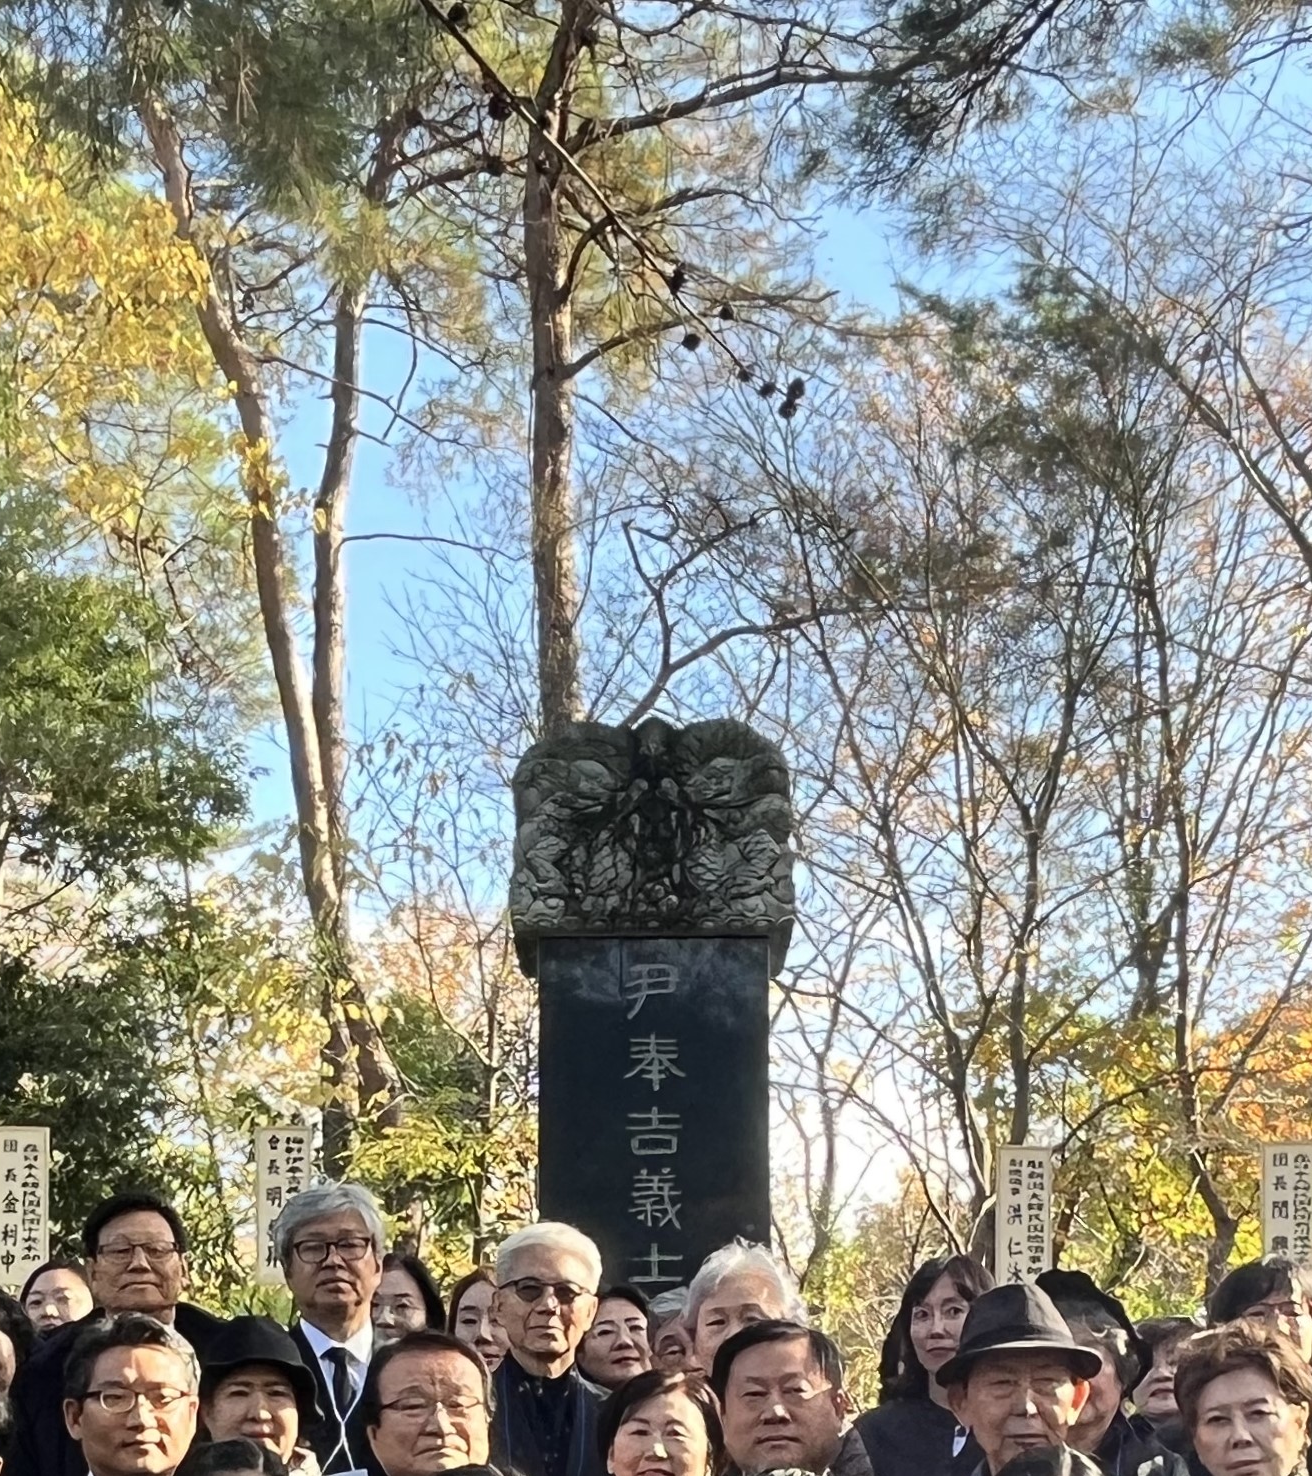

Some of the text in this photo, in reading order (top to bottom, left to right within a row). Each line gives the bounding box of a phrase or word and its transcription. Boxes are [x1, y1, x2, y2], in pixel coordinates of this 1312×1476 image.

[623, 962, 687, 1283] 尹奉吉義士
